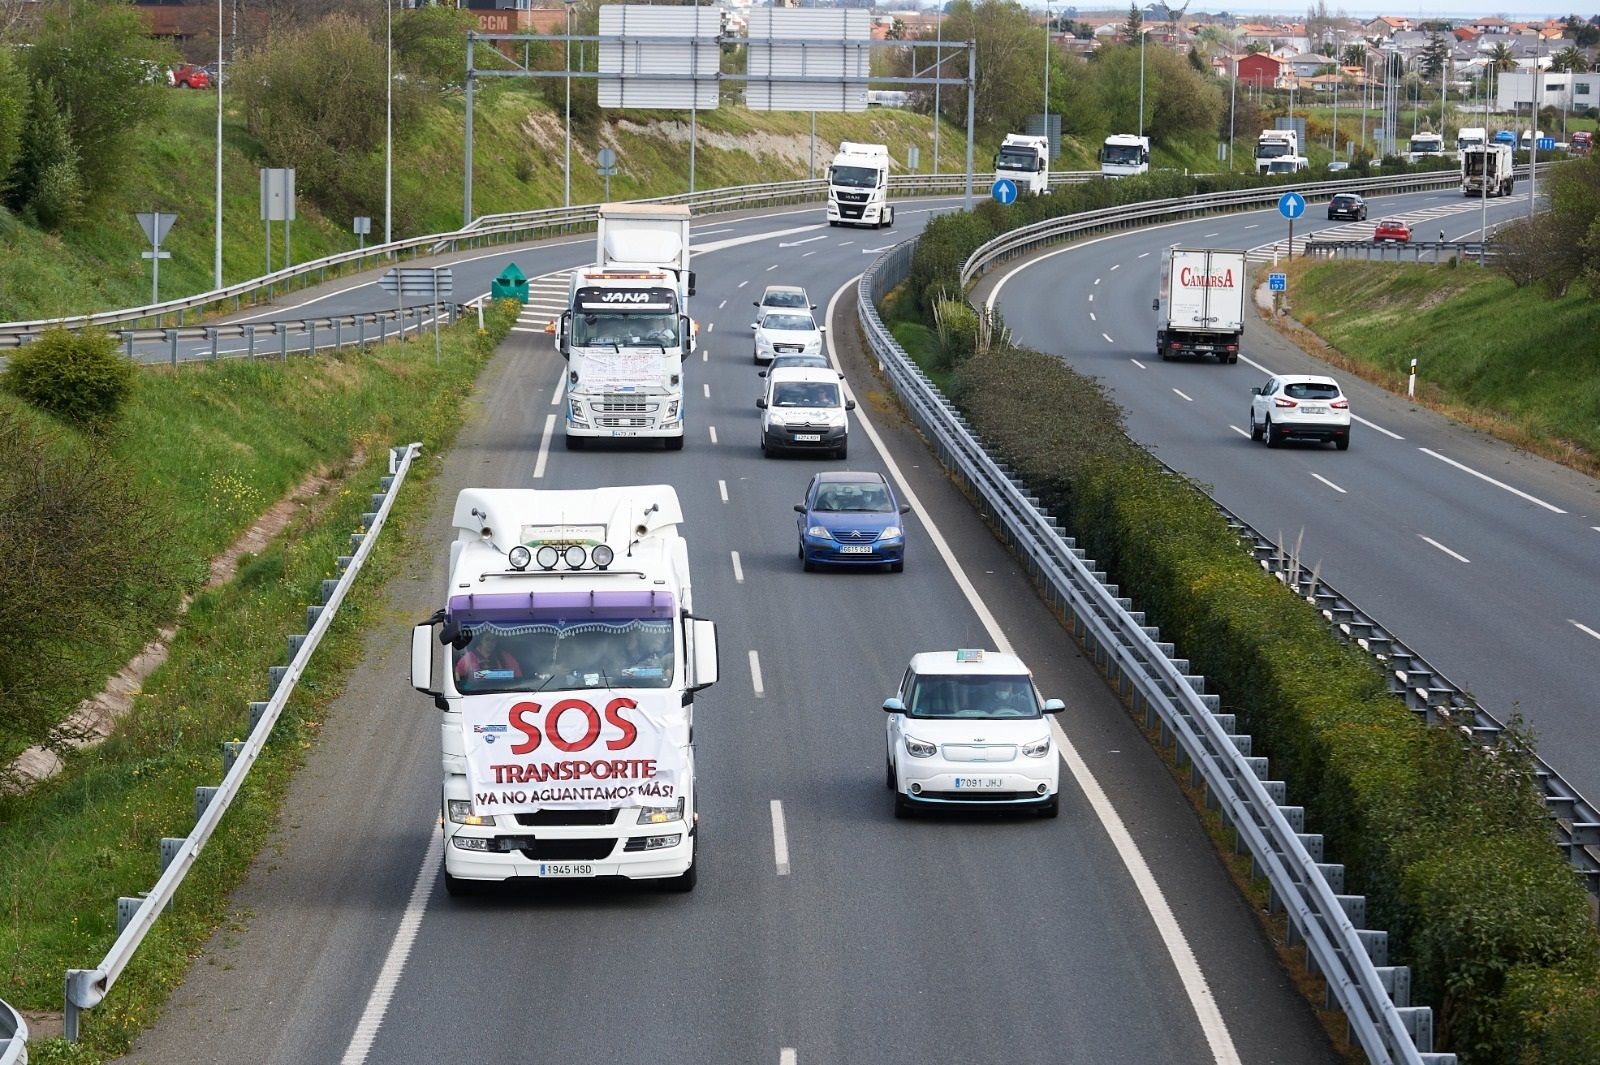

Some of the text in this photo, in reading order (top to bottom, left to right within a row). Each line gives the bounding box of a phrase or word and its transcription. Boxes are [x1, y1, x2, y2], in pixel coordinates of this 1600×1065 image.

[601, 292, 650, 303] JANA
[508, 697, 639, 755] SOS
[490, 759, 657, 784] TRANSPORTE
[960, 778, 1002, 787] 7091 JHJ
[502, 791, 527, 804] NO
[531, 787, 634, 803] AGUANTAMOS
[638, 781, 673, 799] MÁS!
[547, 865, 592, 874] 1945 HSD
